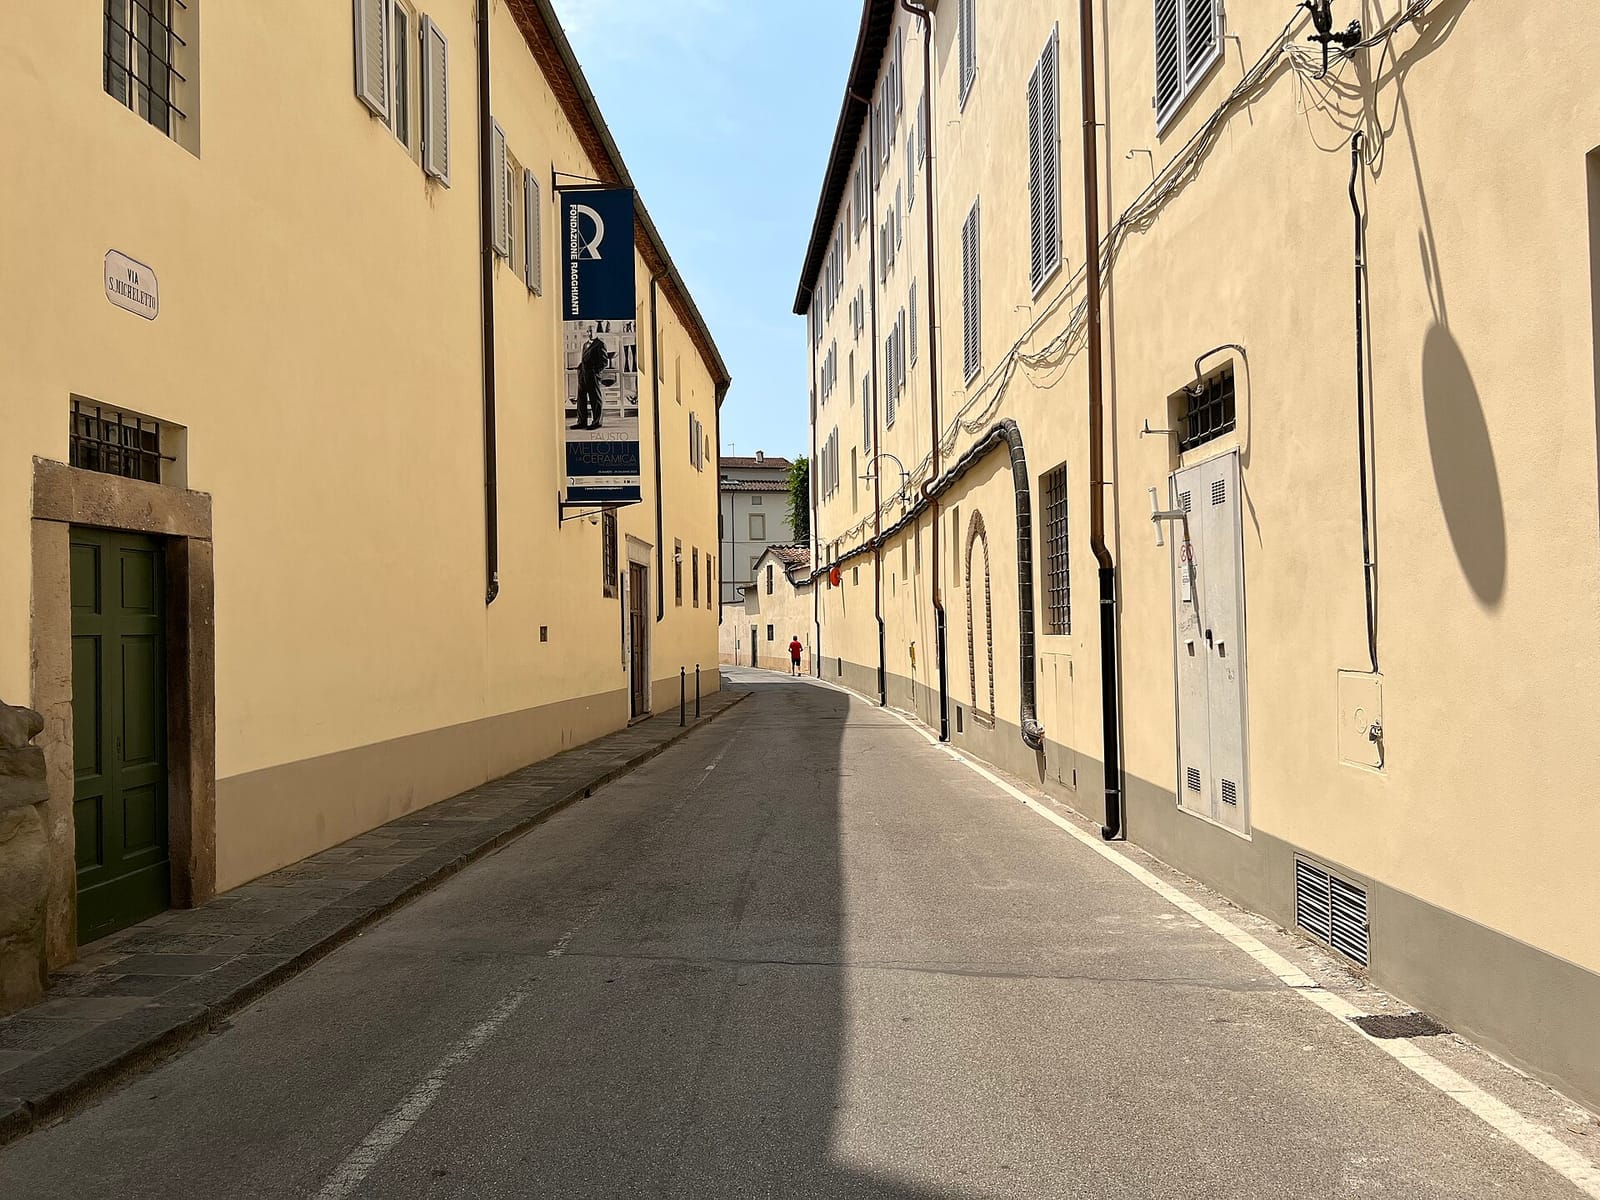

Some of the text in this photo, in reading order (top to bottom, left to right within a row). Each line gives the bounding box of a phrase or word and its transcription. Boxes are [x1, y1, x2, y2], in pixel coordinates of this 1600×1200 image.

[569, 204, 579, 315] FONDAZIONE RAGGHIANTI
[127, 268, 139, 285] VIA
[591, 431, 629, 441] FAUSTO
[569, 442, 630, 455] MELOTTI
[583, 454, 637, 464] CERAMICA
